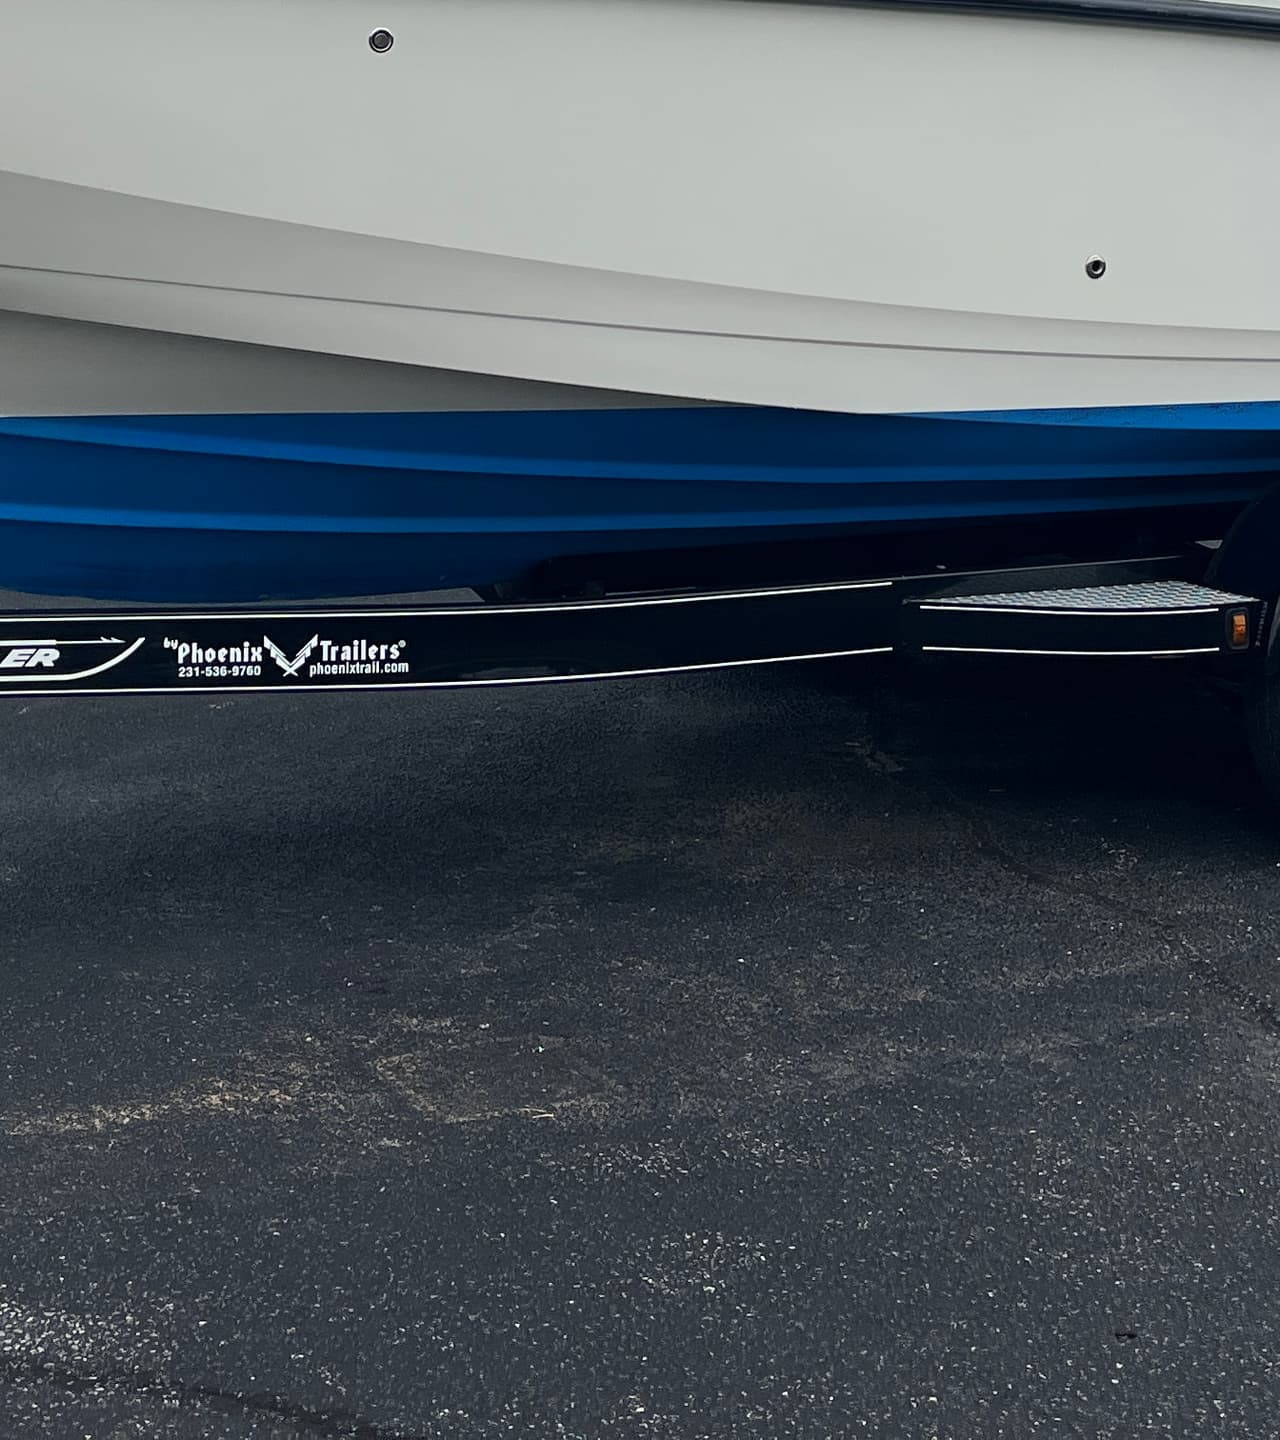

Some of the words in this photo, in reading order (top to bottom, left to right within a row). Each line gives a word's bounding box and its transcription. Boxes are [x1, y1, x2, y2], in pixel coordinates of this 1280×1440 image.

[163, 636, 179, 650] by
[177, 641, 263, 664] Phoenix
[177, 664, 262, 678] 231-536-9760
[309, 661, 410, 678] phoenixtrail.com
